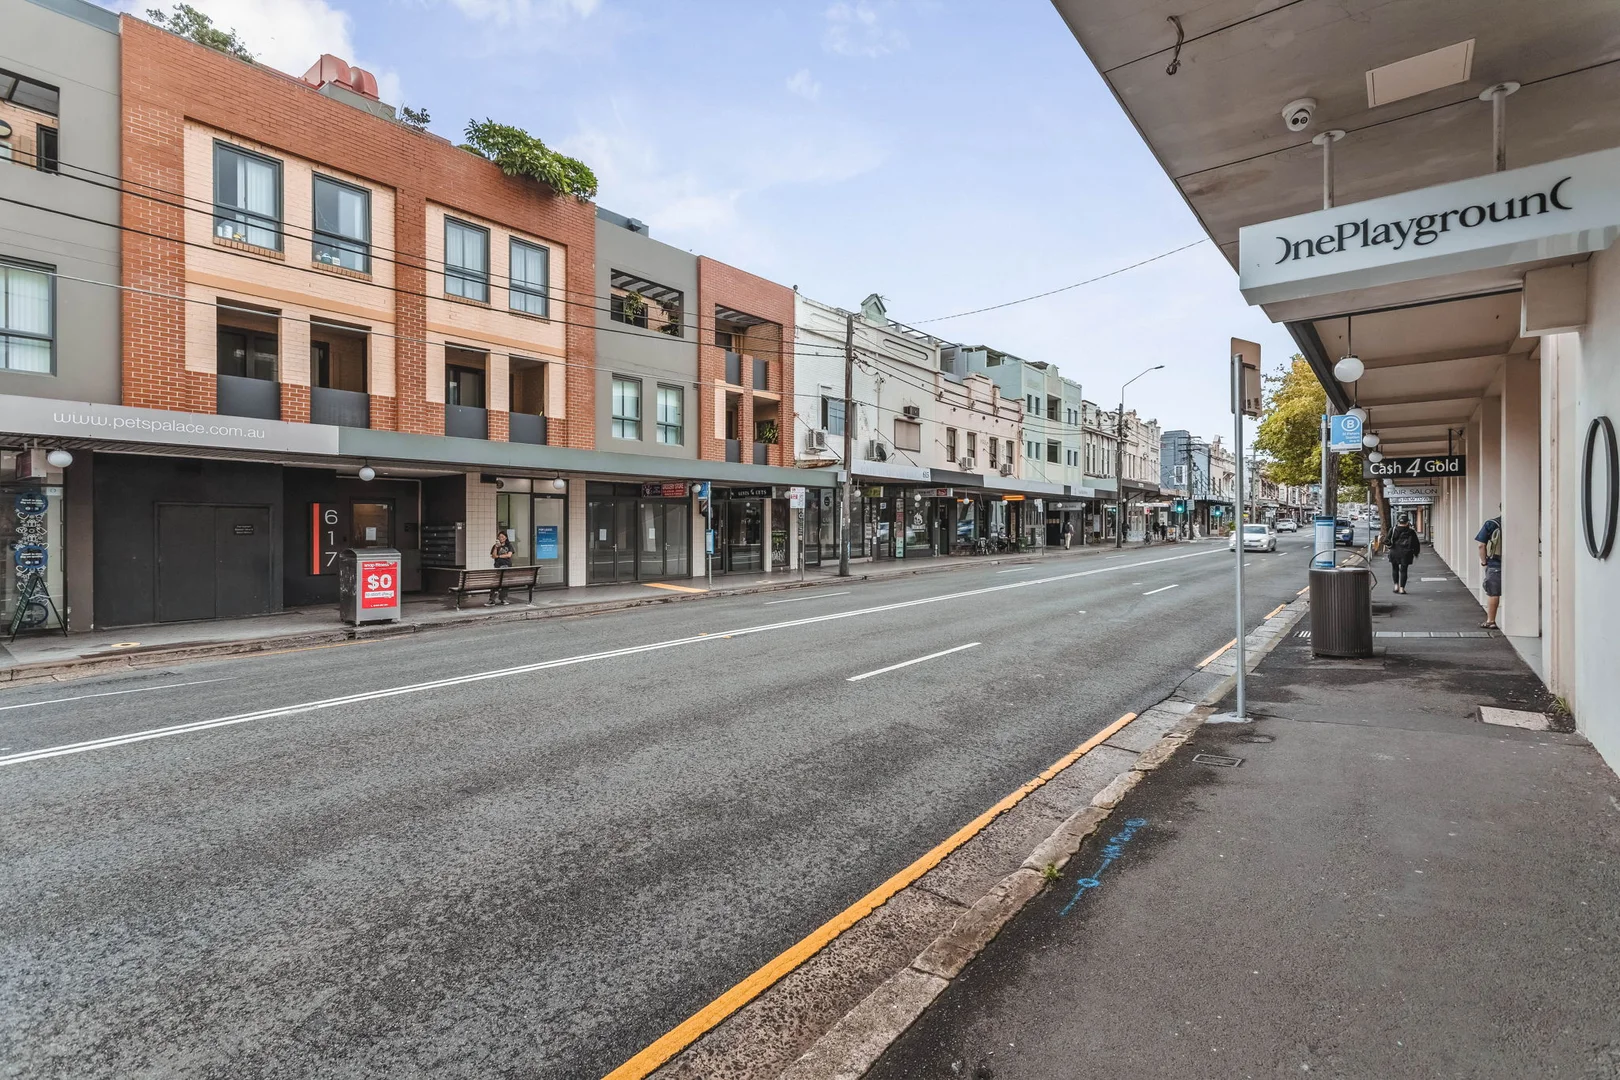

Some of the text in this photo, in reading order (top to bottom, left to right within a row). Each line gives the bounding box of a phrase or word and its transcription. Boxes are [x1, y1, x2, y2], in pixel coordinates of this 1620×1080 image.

[53, 412, 265, 439] www.petspalace.com.au
[1406, 458, 1421, 477] 4
[1424, 458, 1459, 473] Gold
[367, 573, 392, 591] $0
